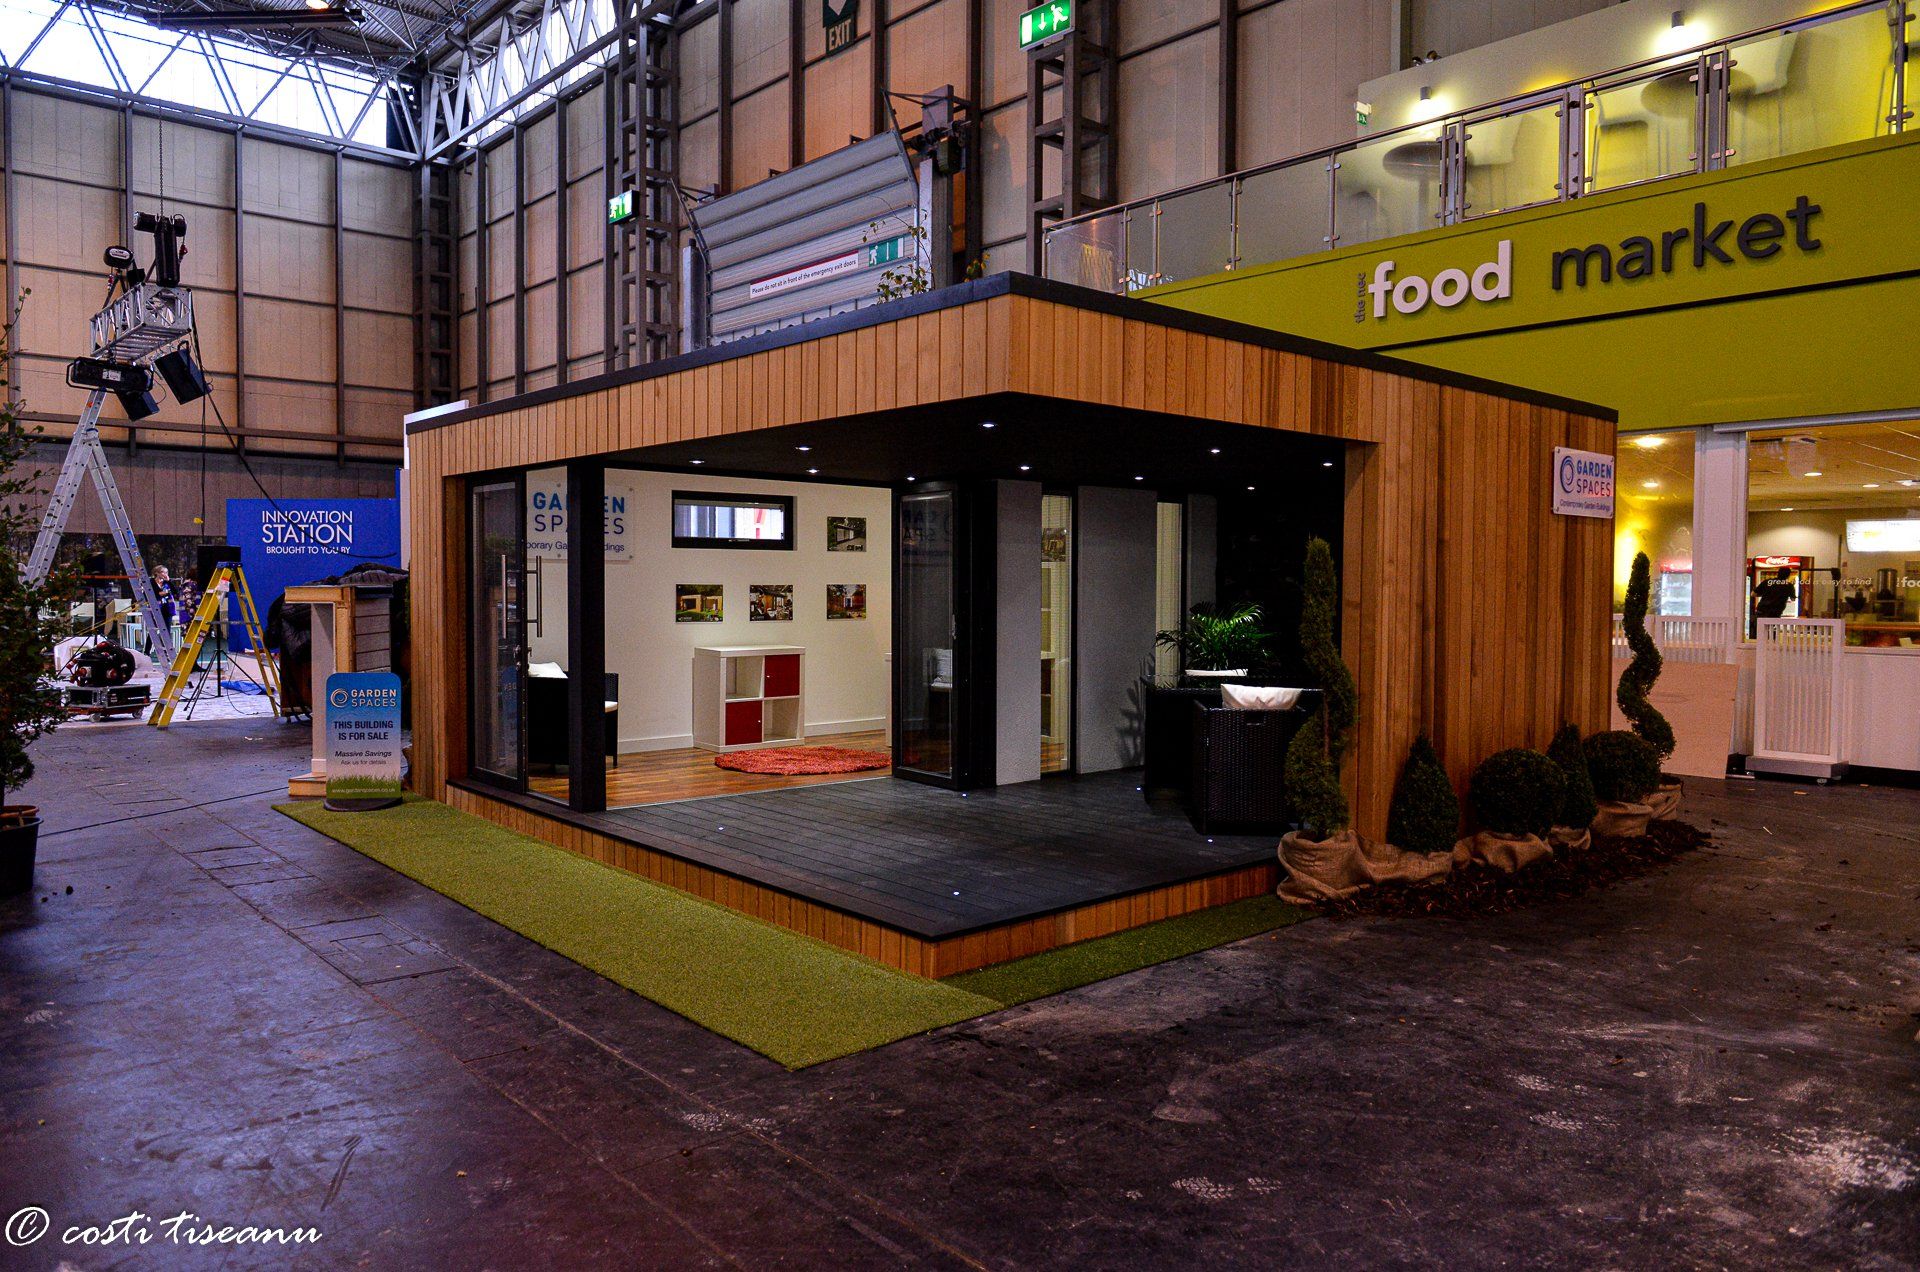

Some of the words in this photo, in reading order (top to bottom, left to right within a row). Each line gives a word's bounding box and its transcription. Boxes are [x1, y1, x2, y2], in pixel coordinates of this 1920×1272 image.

[828, 19, 851, 51] EXIT
[1368, 239, 1513, 318] food
[1551, 195, 1822, 291] market
[811, 266, 833, 276] emergency
[834, 262, 843, 270] exit
[843, 260, 857, 268] doors
[1357, 272, 1366, 297] nec
[1354, 300, 1366, 324] the
[1577, 460, 1611, 479] GARDEN
[1577, 479, 1610, 497] SPACES
[262, 510, 353, 524] INNOVATION
[261, 523, 353, 544] STATION
[266, 546, 305, 555] BROUGHT
[307, 546, 319, 555] TO
[320, 546, 339, 555] YOU
[1767, 578, 1788, 587] great
[1854, 577, 1872, 585] find
[351, 689, 396, 697] GARDEN
[351, 699, 396, 707] SPACES
[334, 721, 352, 729] THIS
[355, 721, 393, 729] BUILDING
[338, 732, 346, 740] IS
[349, 732, 365, 740] FOR
[367, 732, 388, 740] SALE
[364, 750, 392, 758] Savings
